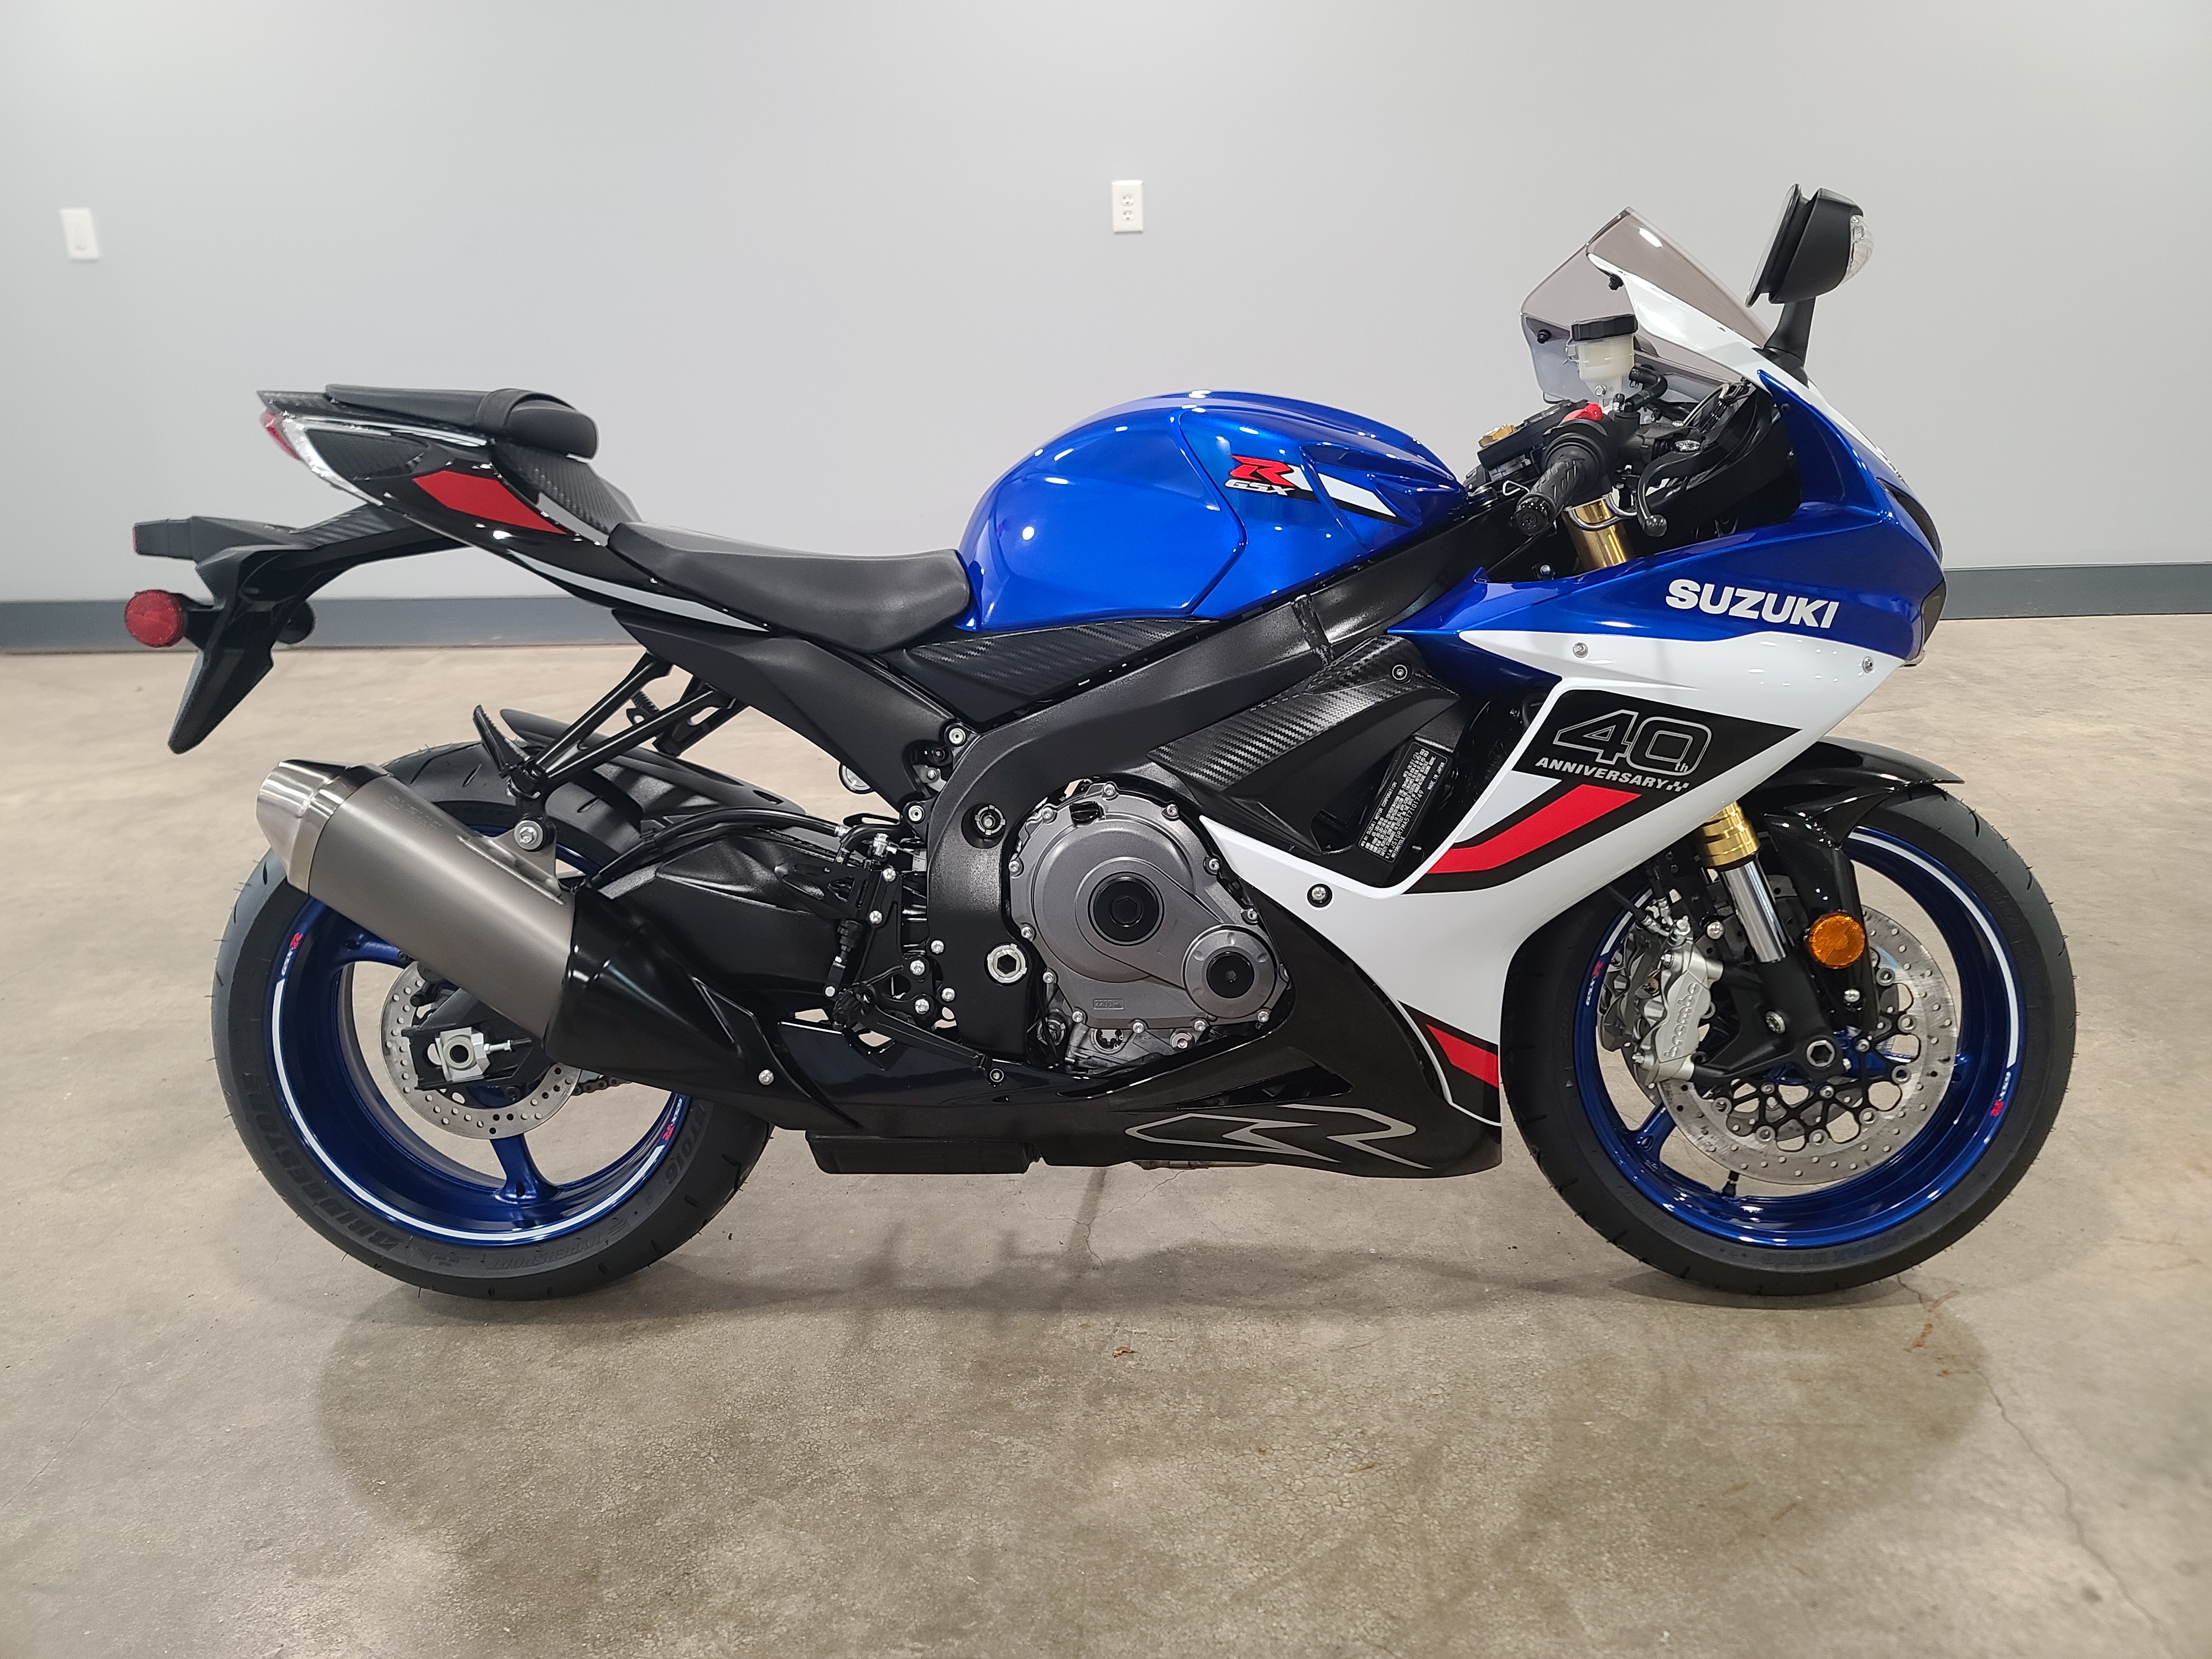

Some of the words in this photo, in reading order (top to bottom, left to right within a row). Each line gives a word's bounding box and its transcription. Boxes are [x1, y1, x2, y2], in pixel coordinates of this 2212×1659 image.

[1224, 479, 1295, 496] GSX
[1666, 579, 1840, 629] SUZUKI
[1436, 761, 1444, 773] JAPAN
[1535, 757, 1670, 790] ANNIVERSARY
[1366, 821, 1376, 834] SUZUKI
[1374, 807, 1383, 820] MOTOR
[1381, 781, 1397, 807] CORPORATION
[1663, 982, 1699, 1057] brembo
[242, 1072, 404, 1251] BRIDGESTONE
